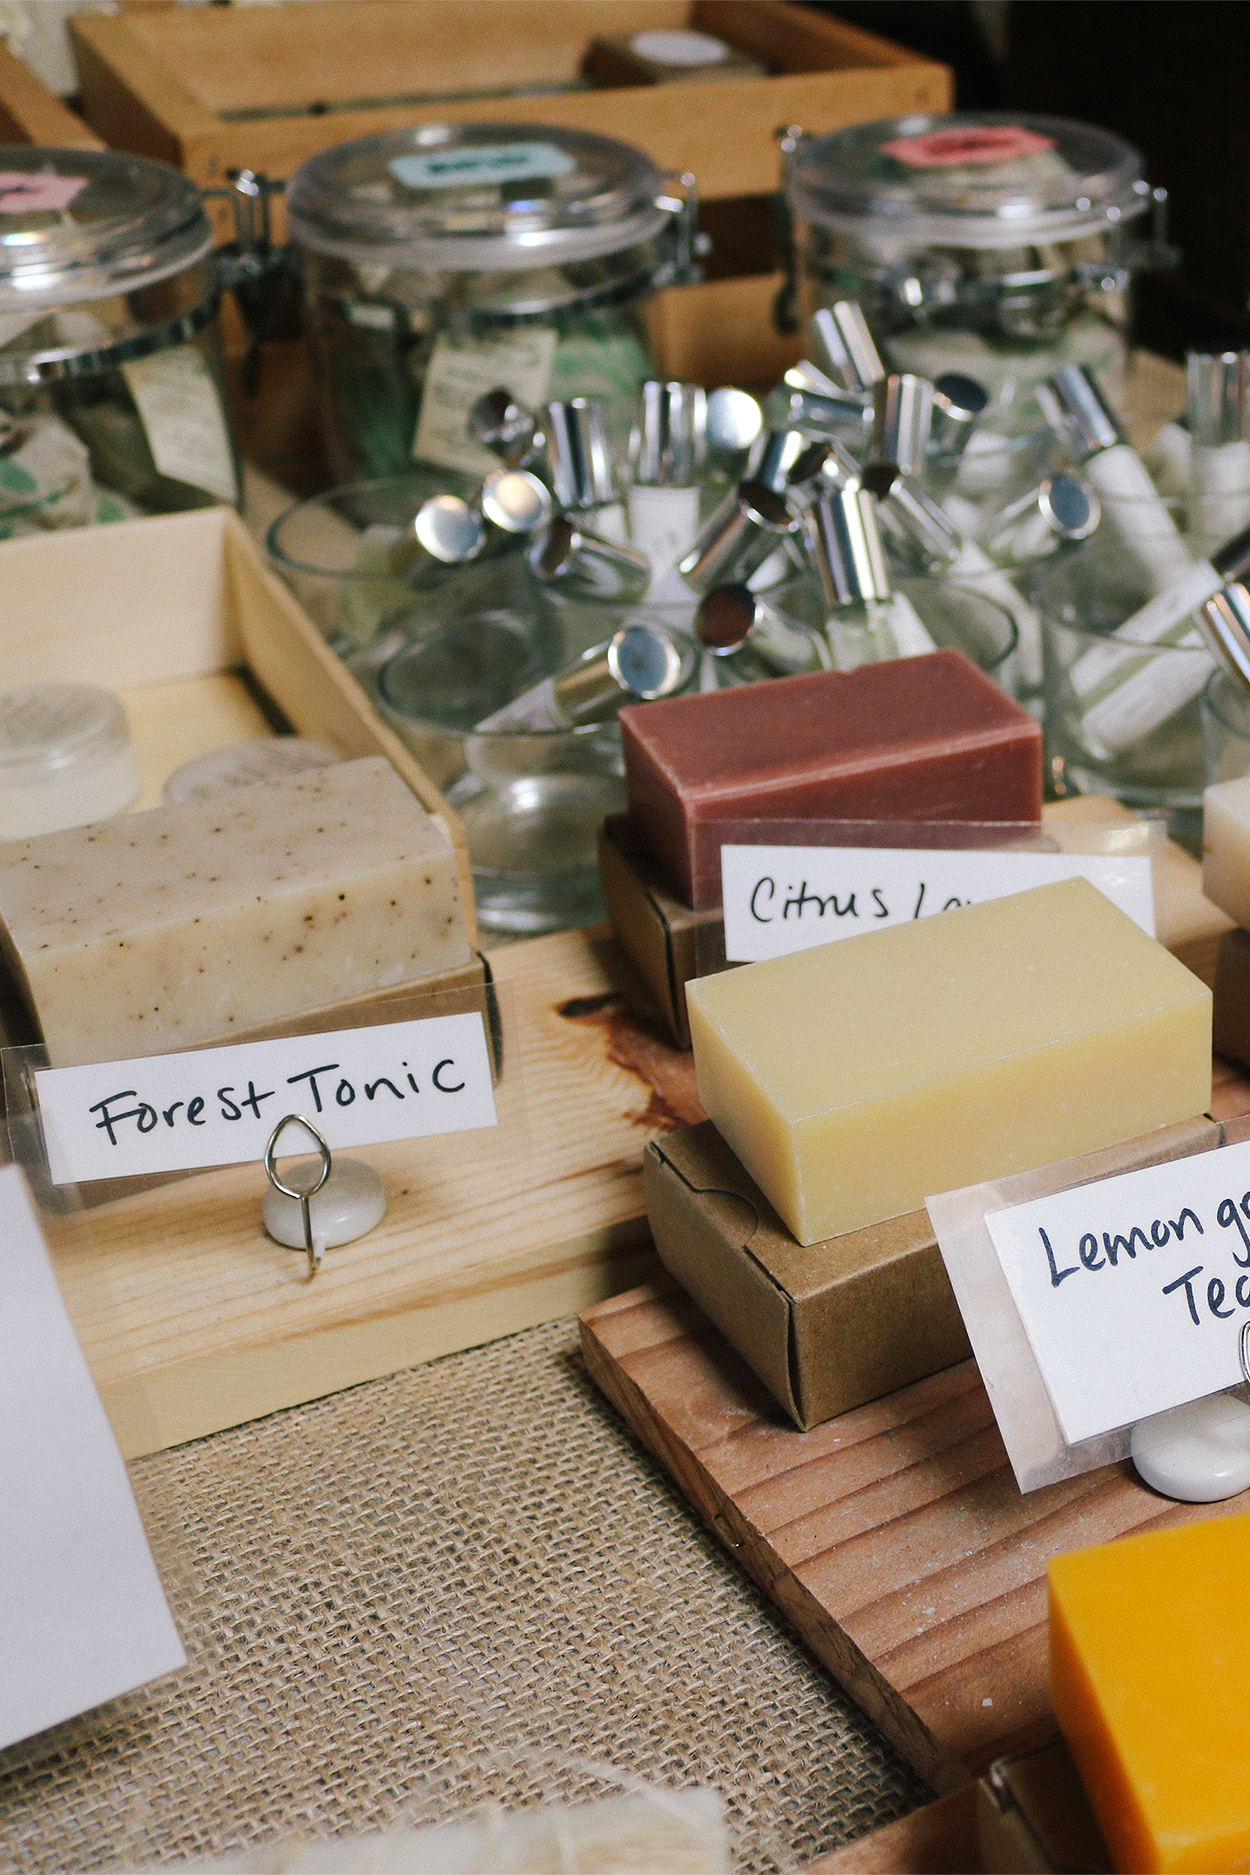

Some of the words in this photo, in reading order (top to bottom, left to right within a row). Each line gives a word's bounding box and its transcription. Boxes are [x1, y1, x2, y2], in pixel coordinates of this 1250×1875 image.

[750, 876, 889, 923] Citrus
[89, 1080, 276, 1146] Forest
[287, 1058, 466, 1113] Tonic
